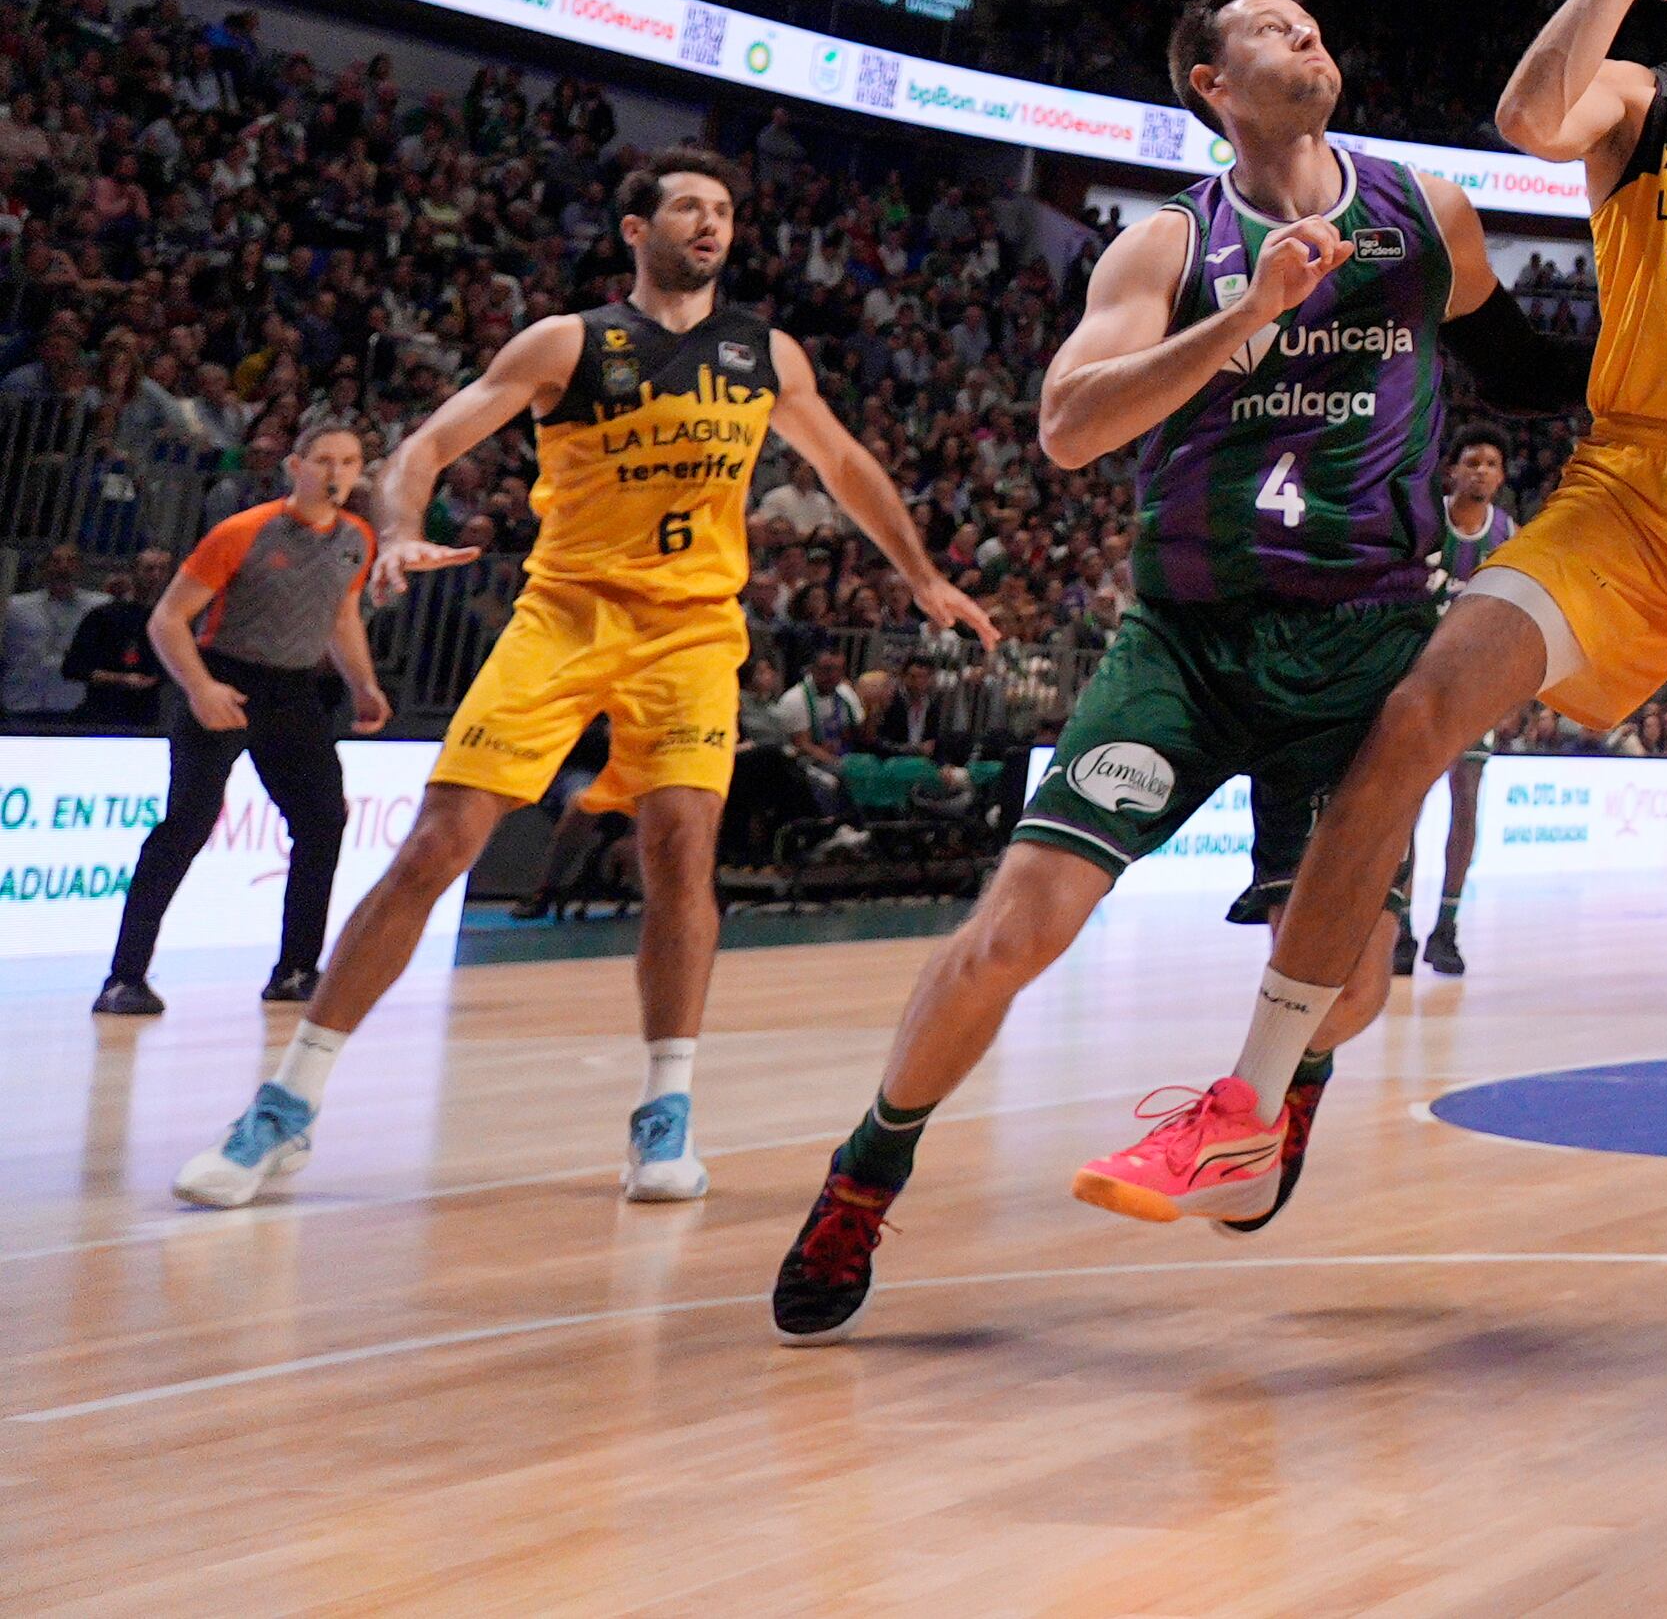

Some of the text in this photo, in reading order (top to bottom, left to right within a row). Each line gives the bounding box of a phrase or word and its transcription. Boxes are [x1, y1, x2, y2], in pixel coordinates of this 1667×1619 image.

[907, 79, 1136, 143] bpBon.us/1000euros
[1279, 318, 1414, 360] Unicaja
[1231, 381, 1376, 425] málaga
[603, 430, 642, 455] LA
[1254, 451, 1307, 528] 4
[658, 511, 694, 555] 6
[53, 797, 93, 829] EN
[105, 796, 161, 829] TUS
